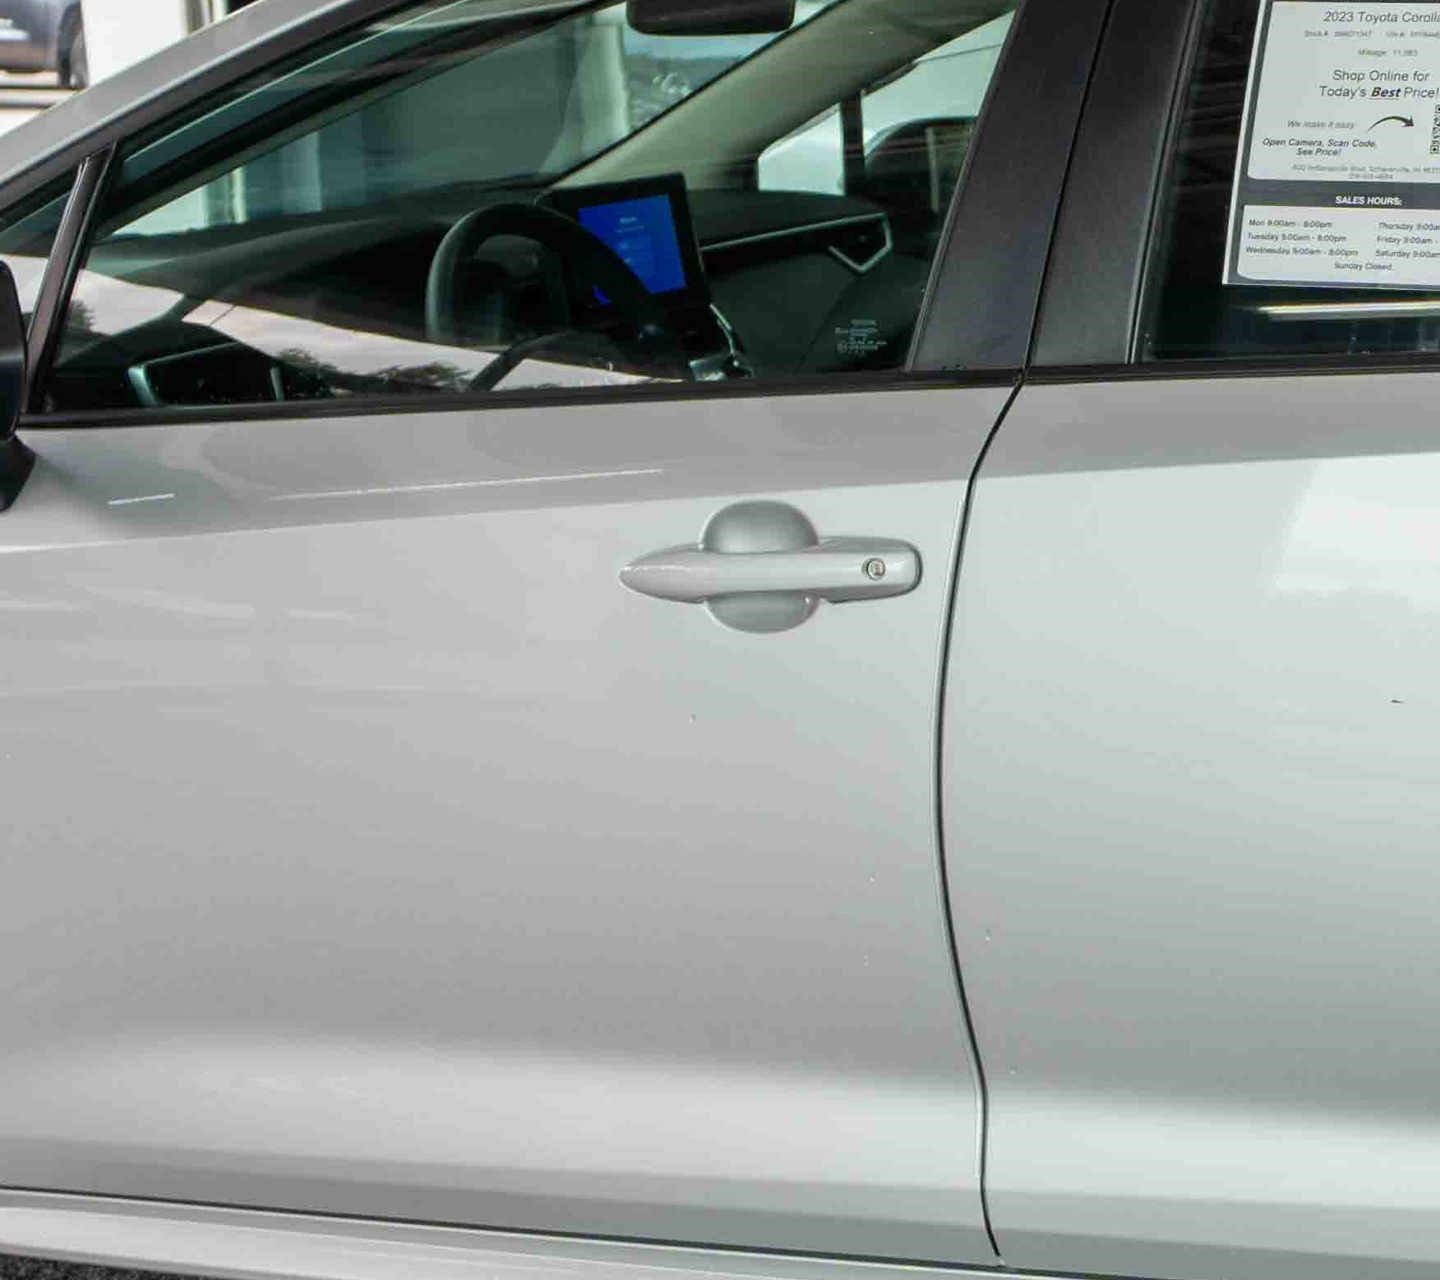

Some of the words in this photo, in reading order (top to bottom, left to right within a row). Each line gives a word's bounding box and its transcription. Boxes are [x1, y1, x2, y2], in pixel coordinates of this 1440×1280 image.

[1323, 10, 1354, 23] 2023
[1358, 10, 1399, 25] Toyota
[1333, 69, 1366, 84] Shop
[1368, 69, 1409, 81] Online
[1413, 70, 1430, 82] for
[1319, 85, 1367, 99] Today's
[1371, 86, 1402, 98] Best
[1403, 86, 1440, 99] Price!
[1262, 138, 1287, 147] Open
[1328, 138, 1349, 148] Scan
[1296, 147, 1313, 156] See
[1335, 195, 1365, 205] SALES
[1366, 196, 1403, 206] HOURS:
[1378, 222, 1414, 232] Thursday
[1248, 232, 1279, 243] Tuesday
[1377, 236, 1401, 246] Friday
[1246, 247, 1291, 256] Wednesday
[1375, 249, 1411, 259] Saturday
[1334, 261, 1362, 271] Sunday
